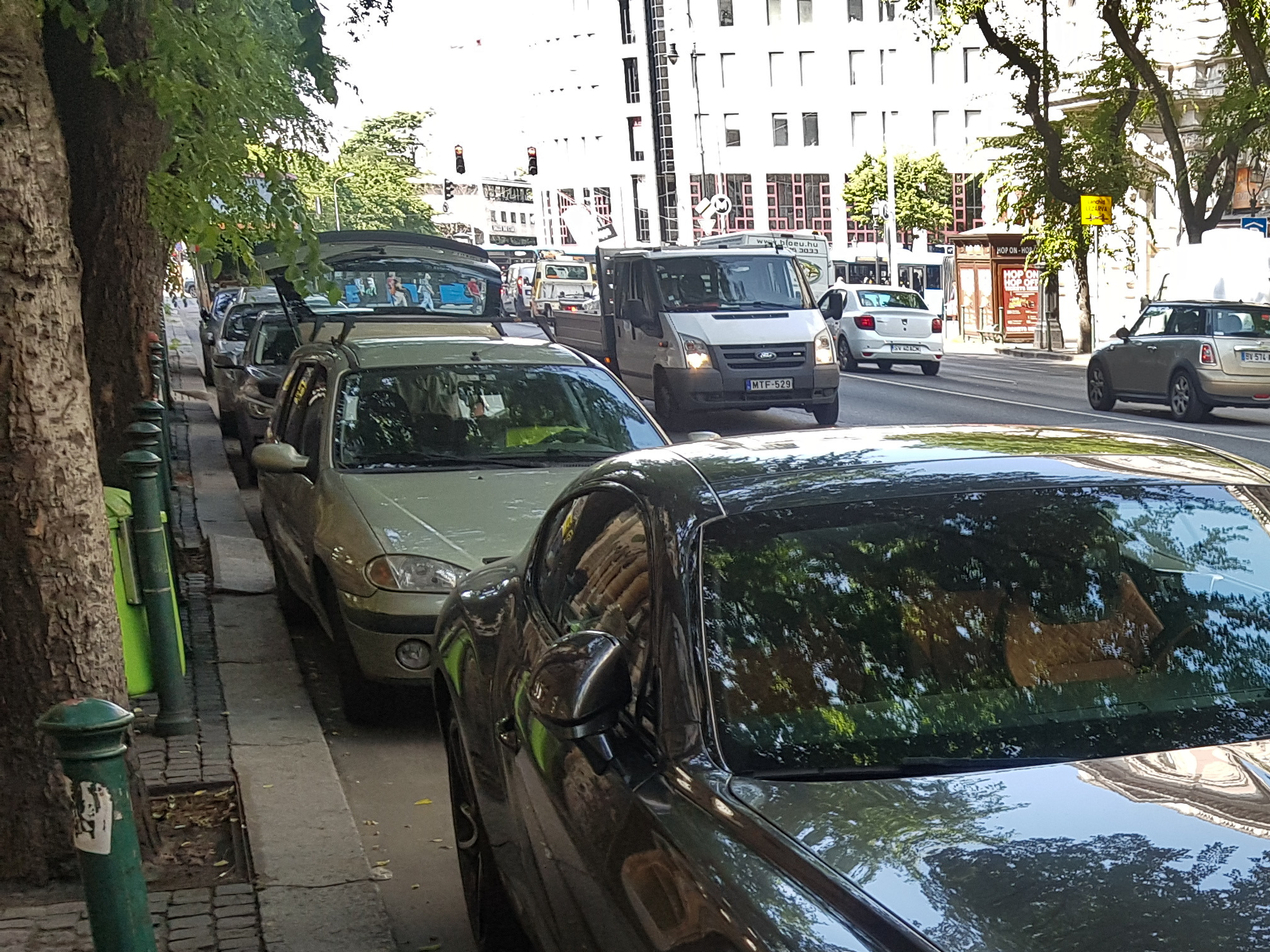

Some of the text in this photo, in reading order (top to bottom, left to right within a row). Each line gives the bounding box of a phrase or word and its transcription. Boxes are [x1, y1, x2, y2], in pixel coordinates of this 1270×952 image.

[997, 246, 1009, 254] HOP
[1009, 246, 1018, 254] ON
[1003, 270, 1039, 279] HOP ON
[1004, 279, 1023, 287] HOP
[752, 380, 791, 389] MTF-529
